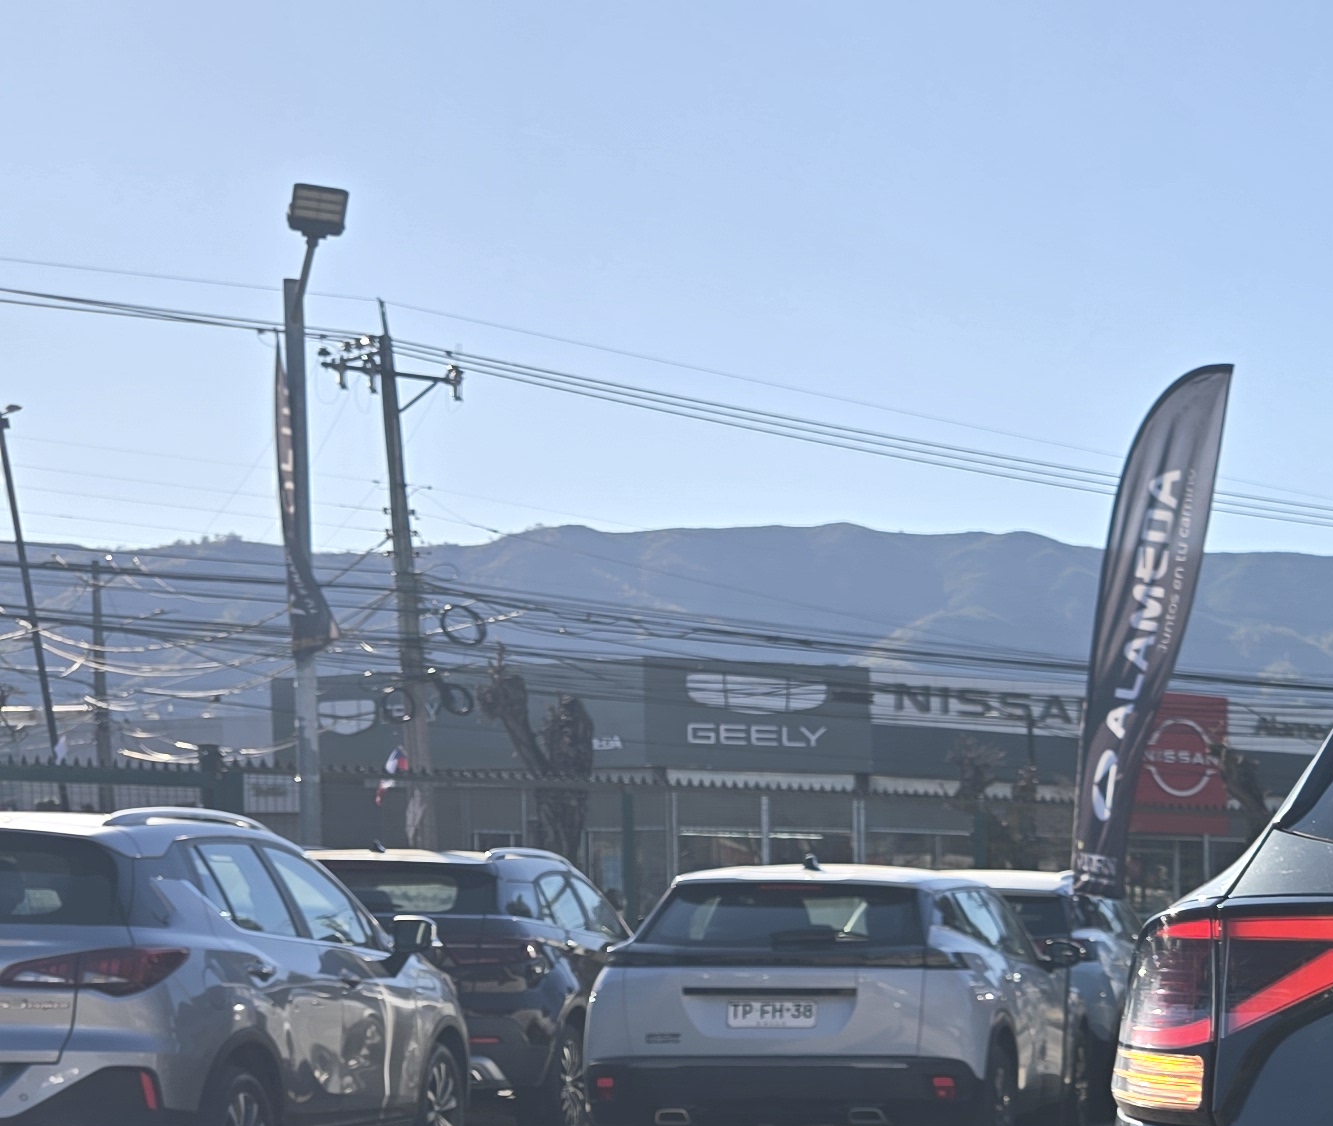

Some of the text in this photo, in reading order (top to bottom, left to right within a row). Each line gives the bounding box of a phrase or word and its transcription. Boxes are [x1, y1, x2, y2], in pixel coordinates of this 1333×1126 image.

[1106, 469, 1181, 740] ALAMEDA
[1157, 594, 1179, 654] Juntos
[687, 722, 828, 748] GEELY
[1143, 750, 1219, 766] NISSAN
